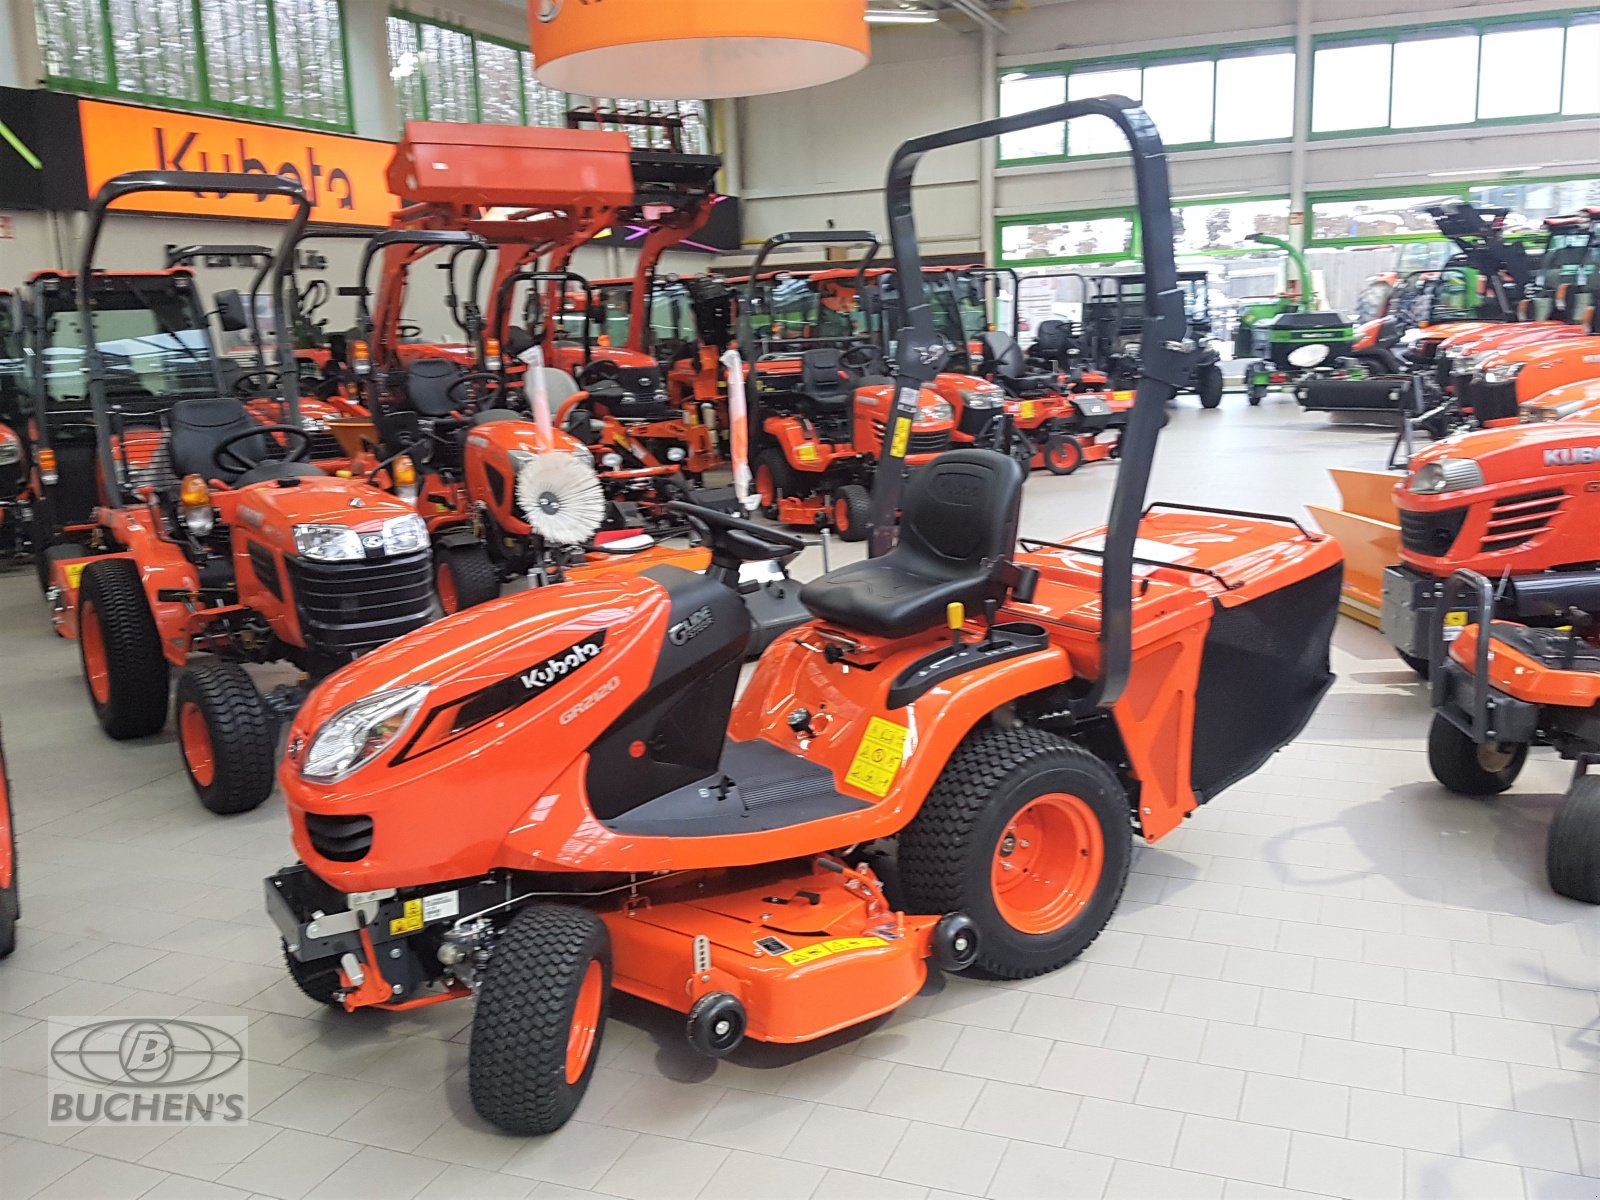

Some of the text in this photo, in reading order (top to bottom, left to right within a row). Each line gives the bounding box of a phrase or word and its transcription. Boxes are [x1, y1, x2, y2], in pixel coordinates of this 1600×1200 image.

[153, 127, 356, 210] Kubota
[520, 642, 602, 689] Kubota
[559, 676, 621, 725] GR2120
